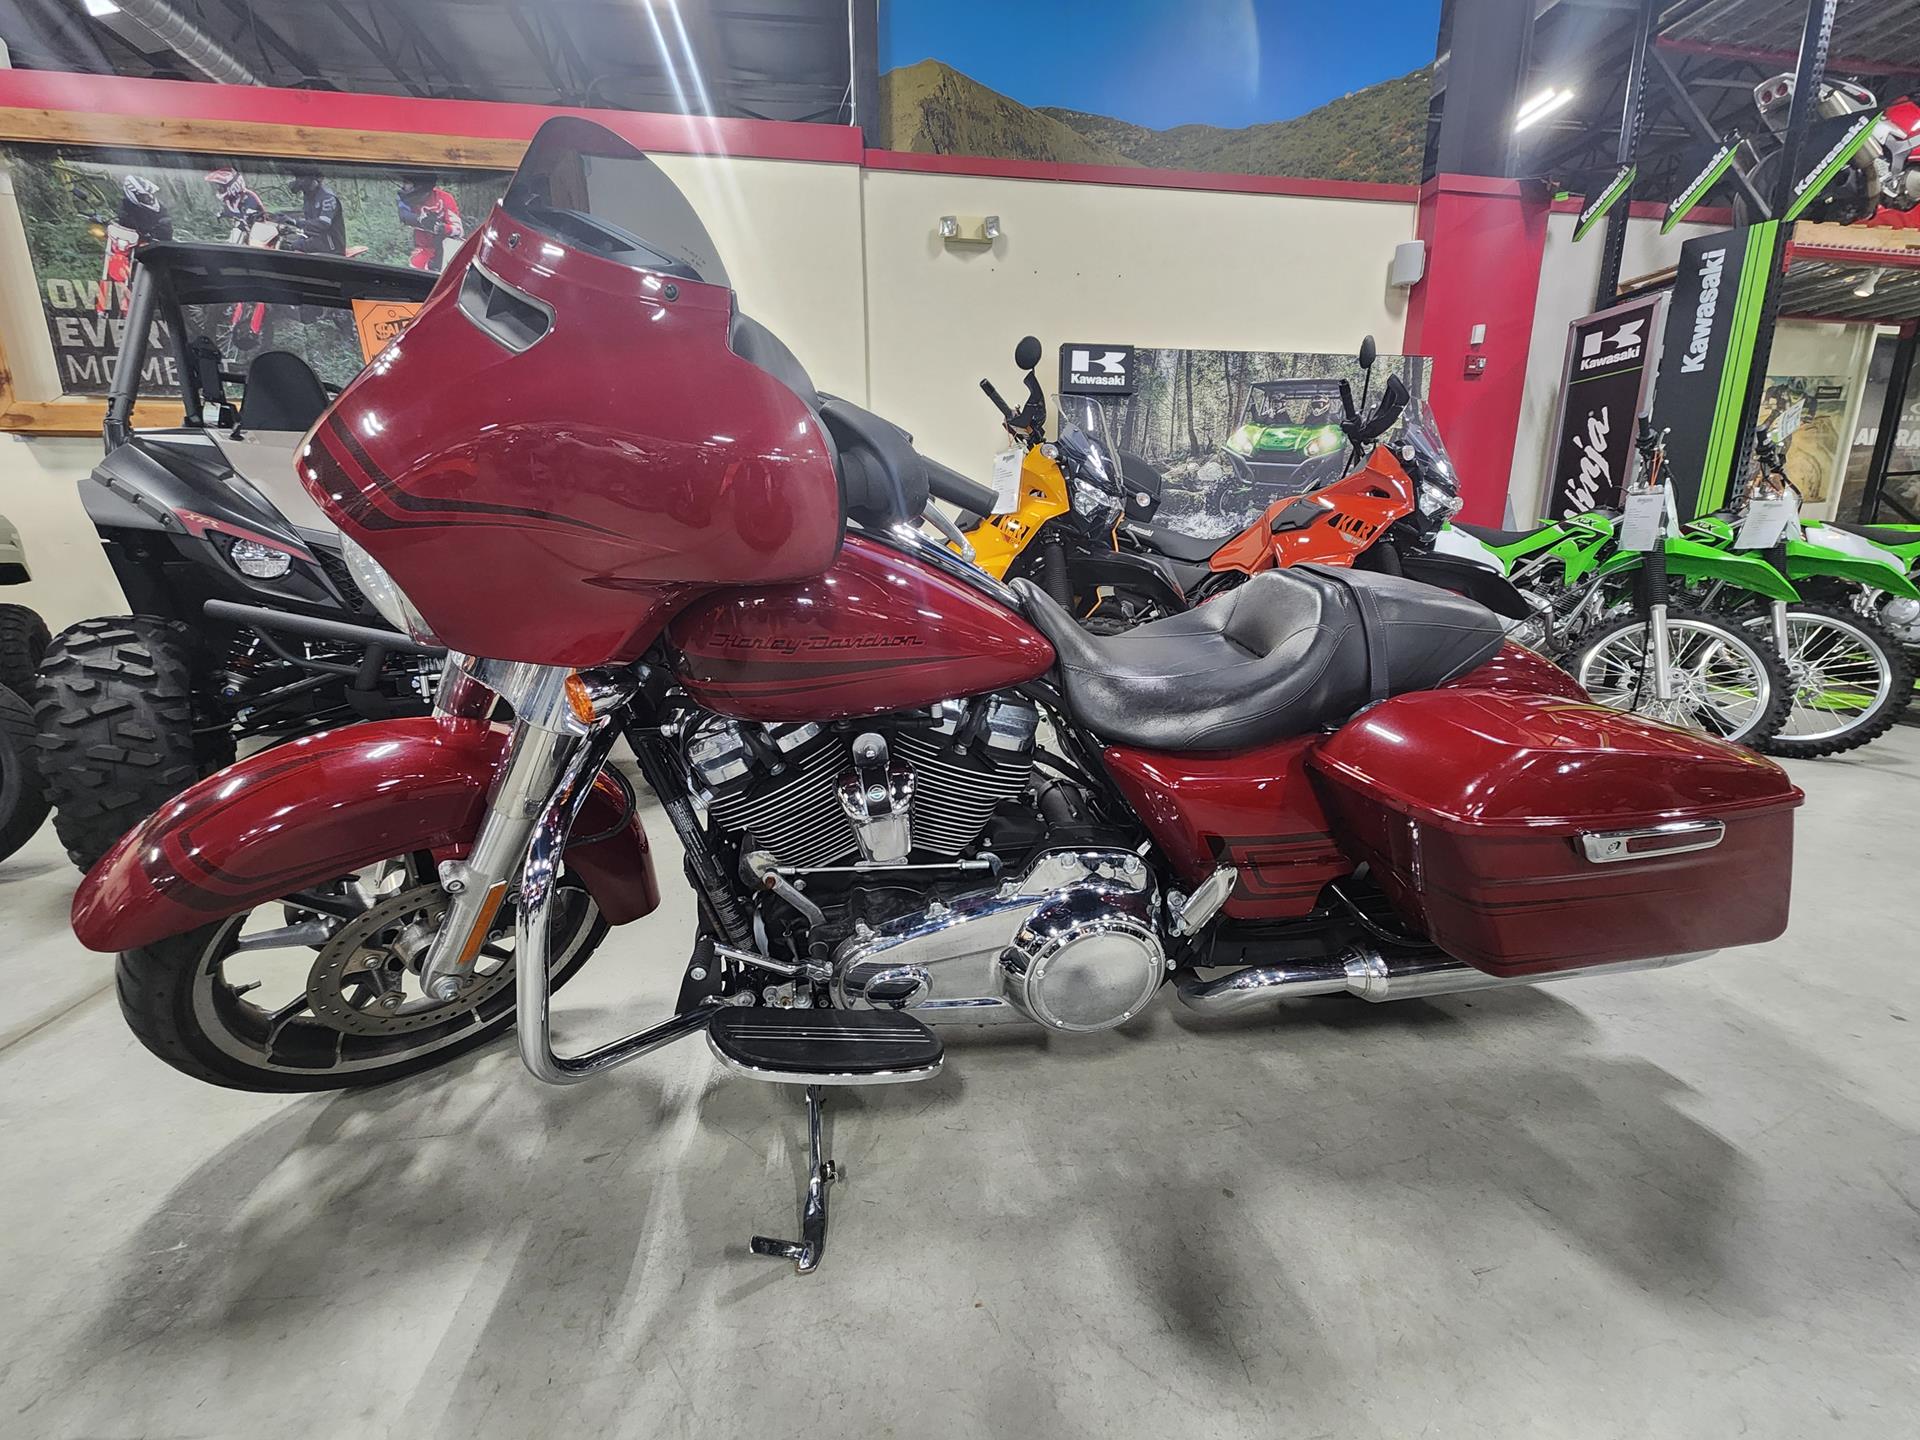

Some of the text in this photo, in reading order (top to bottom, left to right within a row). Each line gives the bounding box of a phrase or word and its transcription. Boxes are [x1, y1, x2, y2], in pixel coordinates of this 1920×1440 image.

[1794, 115, 1869, 196] Kawasaki
[1581, 164, 1630, 223] Kawasaki
[1669, 145, 1729, 213] Kawasaki
[1680, 248, 1726, 374] Kawasaki
[66, 354, 236, 386] MOMET
[1580, 345, 1641, 371] Kawasaki
[1070, 373, 1126, 386] Kawasaki
[1336, 512, 1377, 540] KLR
[708, 633, 925, 655] Harley-Davidson
